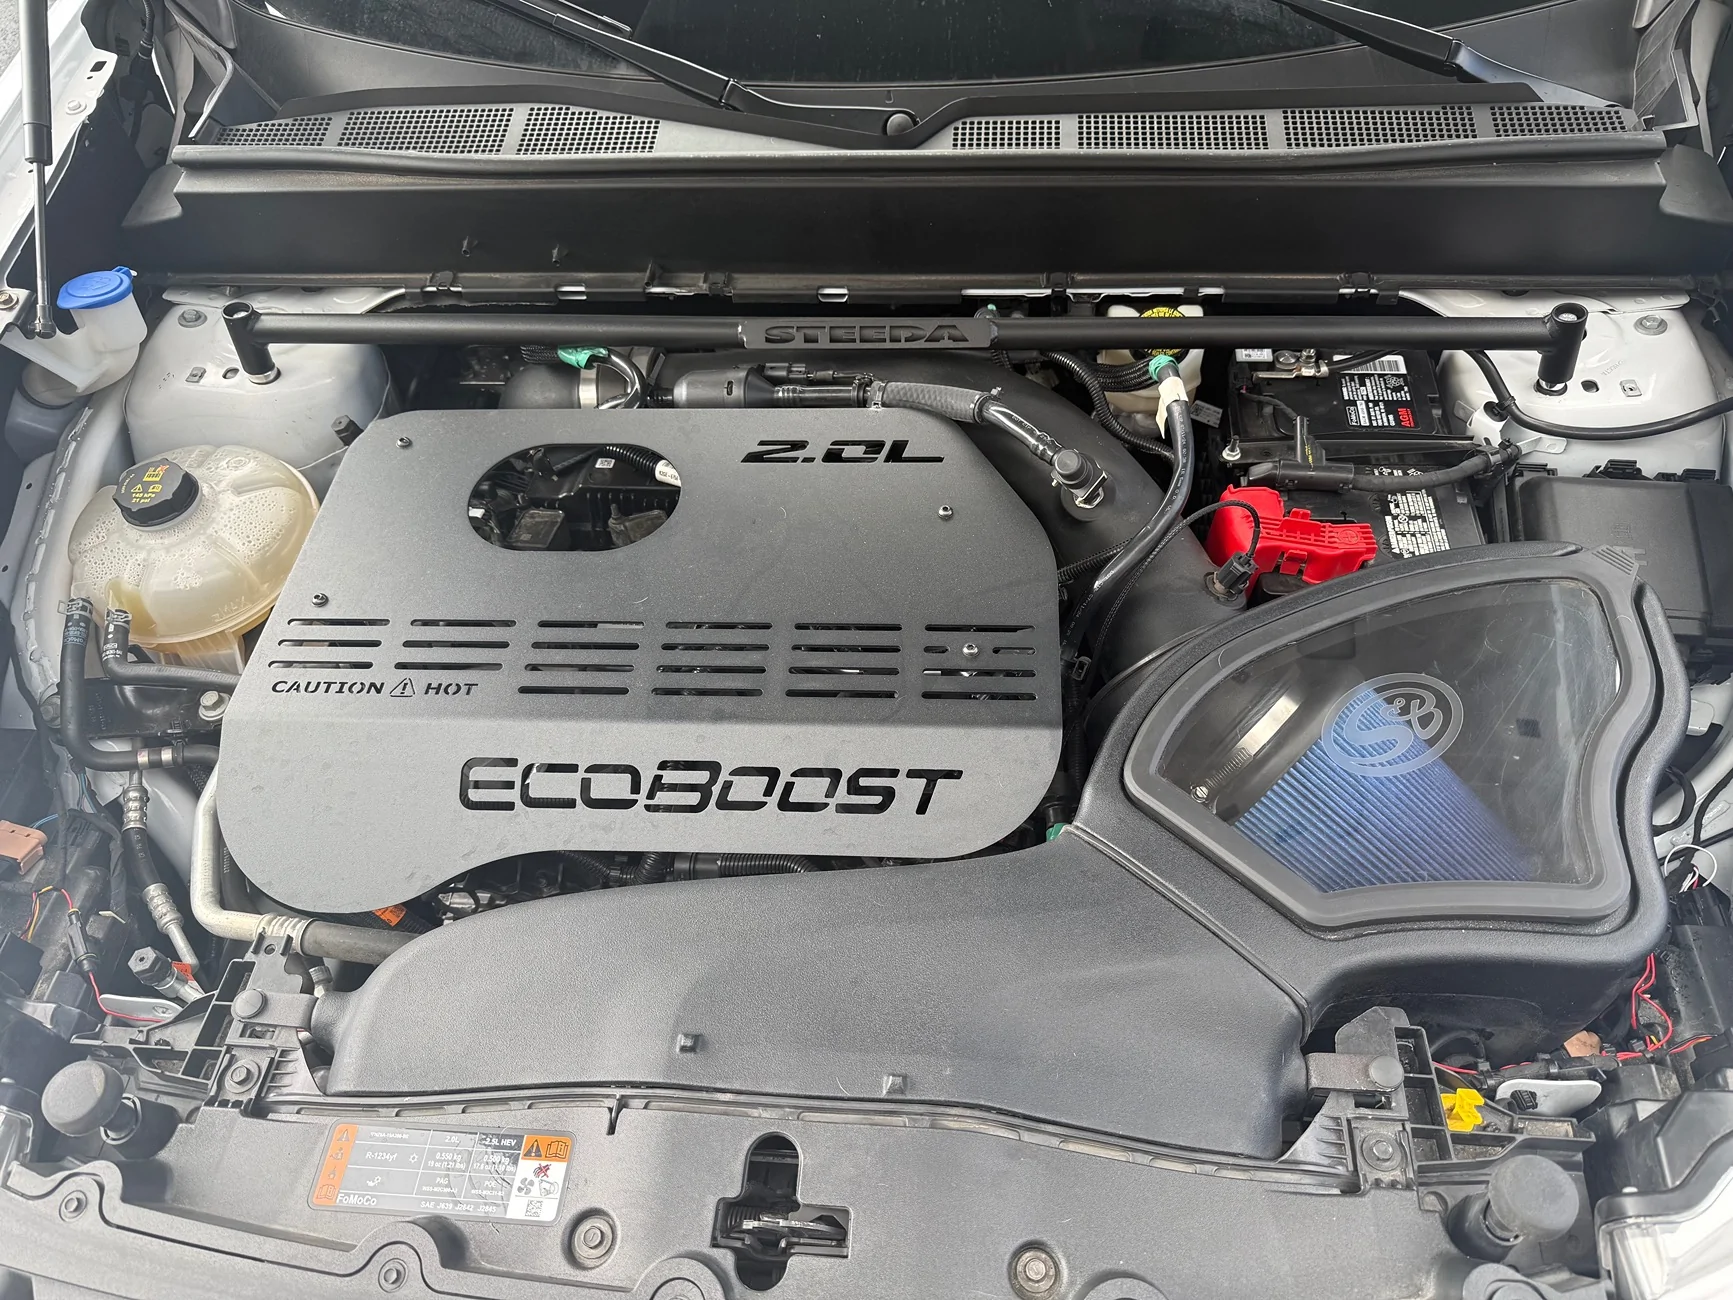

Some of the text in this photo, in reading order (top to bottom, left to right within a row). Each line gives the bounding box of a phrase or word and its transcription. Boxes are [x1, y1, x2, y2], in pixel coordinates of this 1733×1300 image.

[764, 325, 969, 344] STEEDA
[1398, 408, 1410, 427] AGM
[741, 439, 945, 464] 2.0L
[271, 680, 479, 696] CAUTION HOT
[459, 757, 964, 815] ECOBOOST
[444, 1135, 460, 1143] 2.0L
[501, 1138, 517, 1147] HEV
[365, 1151, 398, 1162] R-1234yf
[435, 1151, 462, 1162] 0.550 kg
[501, 1156, 510, 1165] kg
[336, 1193, 377, 1206] FoMoCo
[420, 1201, 435, 1209] SAE
